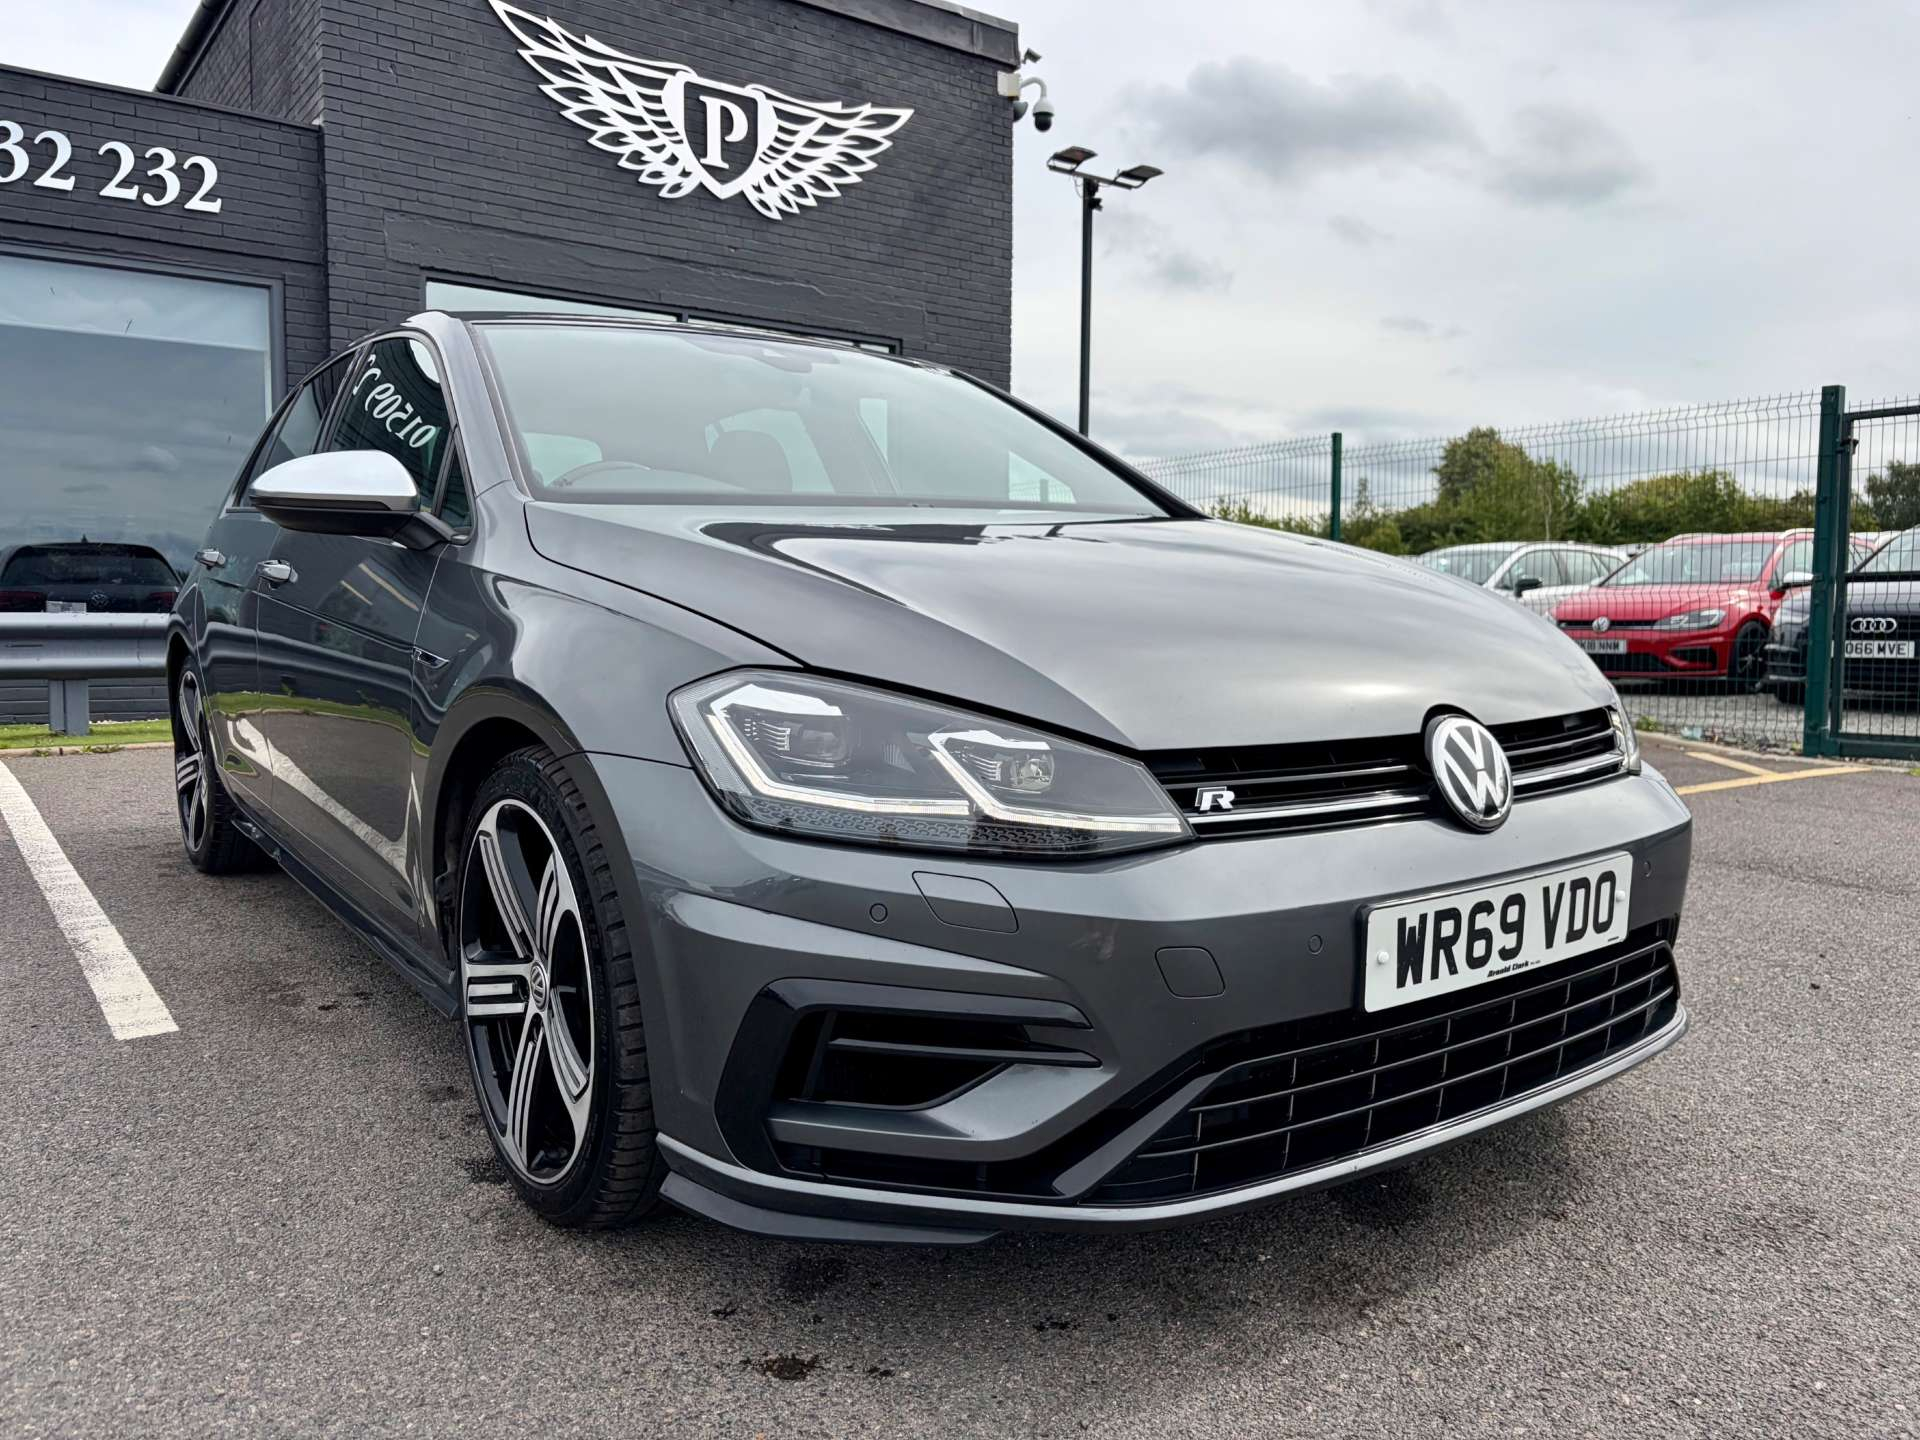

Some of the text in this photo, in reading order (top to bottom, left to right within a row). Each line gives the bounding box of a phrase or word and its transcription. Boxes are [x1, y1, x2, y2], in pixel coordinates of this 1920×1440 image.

[698, 95, 749, 170] P
[0, 120, 222, 214] 32 232
[1877, 643, 1907, 656] MVE
[1195, 786, 1235, 811] R
[1396, 870, 1617, 989] WR69 VDO
[1512, 960, 1529, 971] Clark
